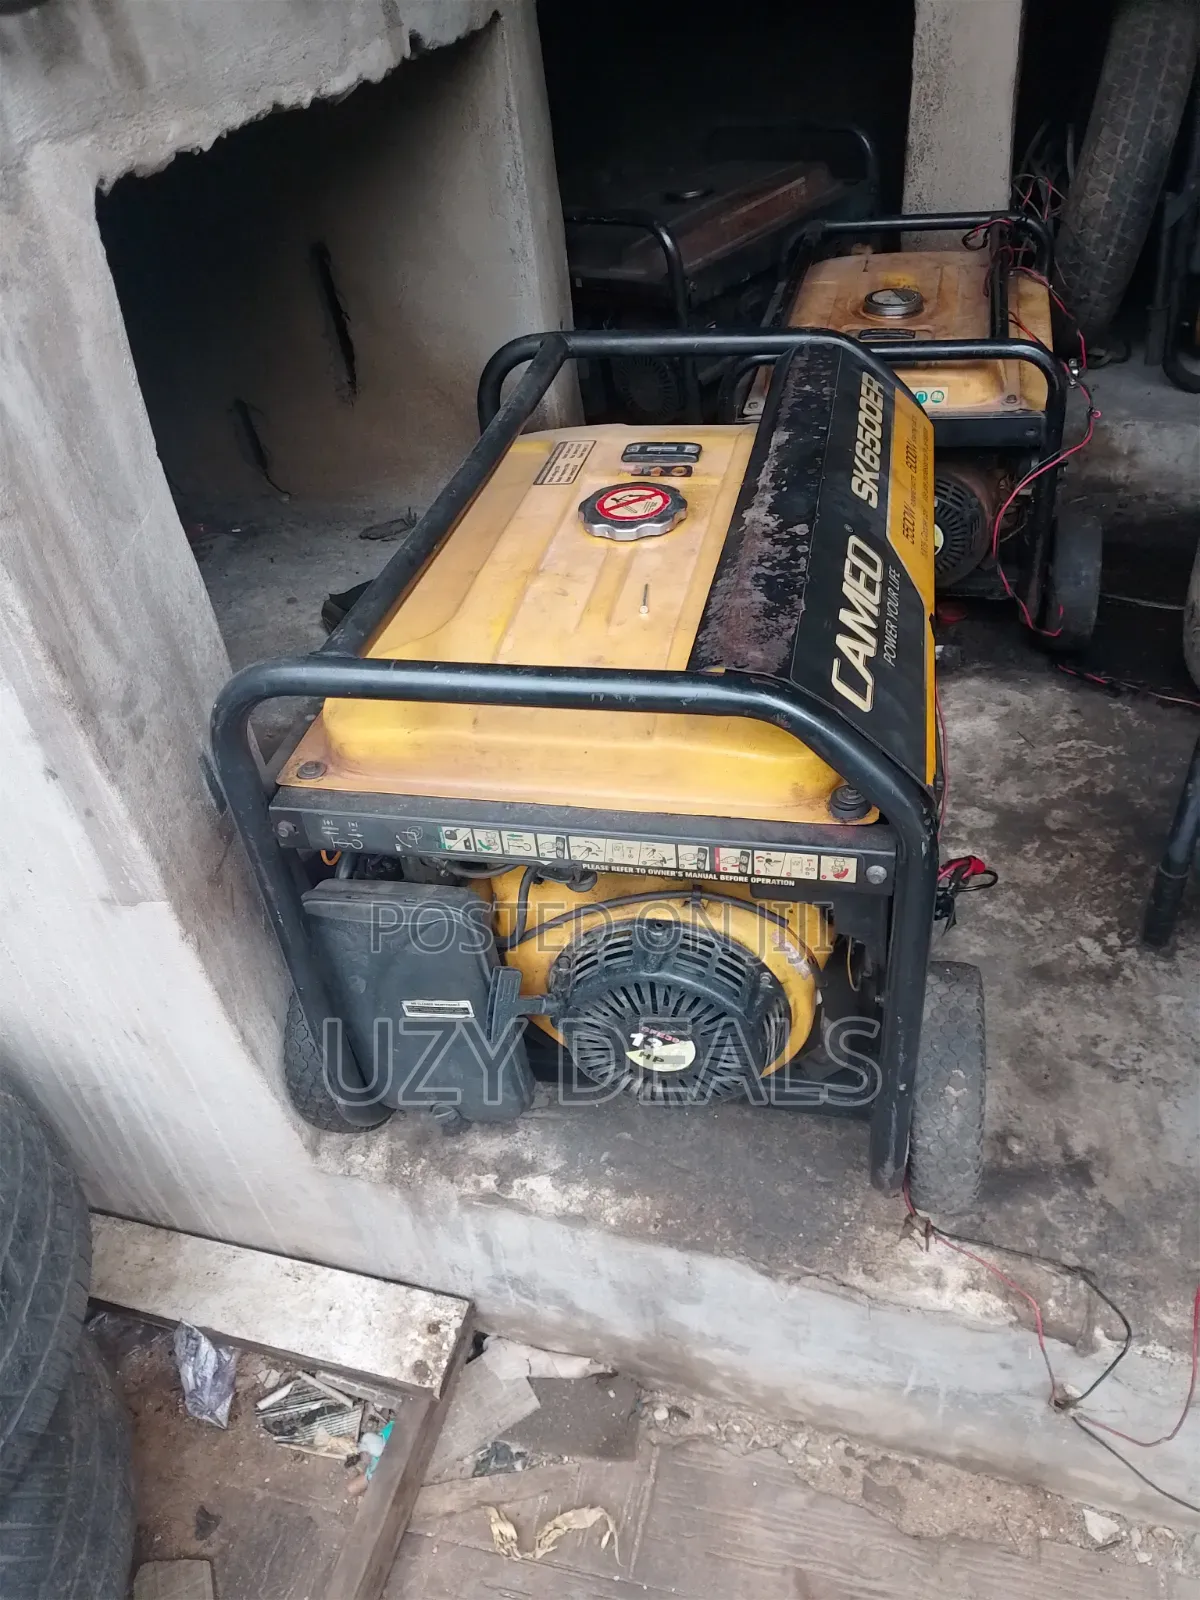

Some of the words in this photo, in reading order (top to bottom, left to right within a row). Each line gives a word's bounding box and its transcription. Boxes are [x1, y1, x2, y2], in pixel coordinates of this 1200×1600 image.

[851, 371, 885, 509] SK6500ER
[888, 564, 901, 591] LIFE
[886, 587, 899, 621] YOUR
[831, 534, 884, 713] CAMEO
[883, 619, 898, 667] POWER
[582, 863, 609, 871] PLEASE
[611, 865, 634, 873] REFER
[648, 868, 683, 877] OWNER'S
[685, 872, 718, 880] MANUAL
[720, 874, 748, 883] BEFORE
[751, 877, 795, 887] OPERATION
[630, 1032, 663, 1051] 13
[639, 1051, 664, 1063] HP
